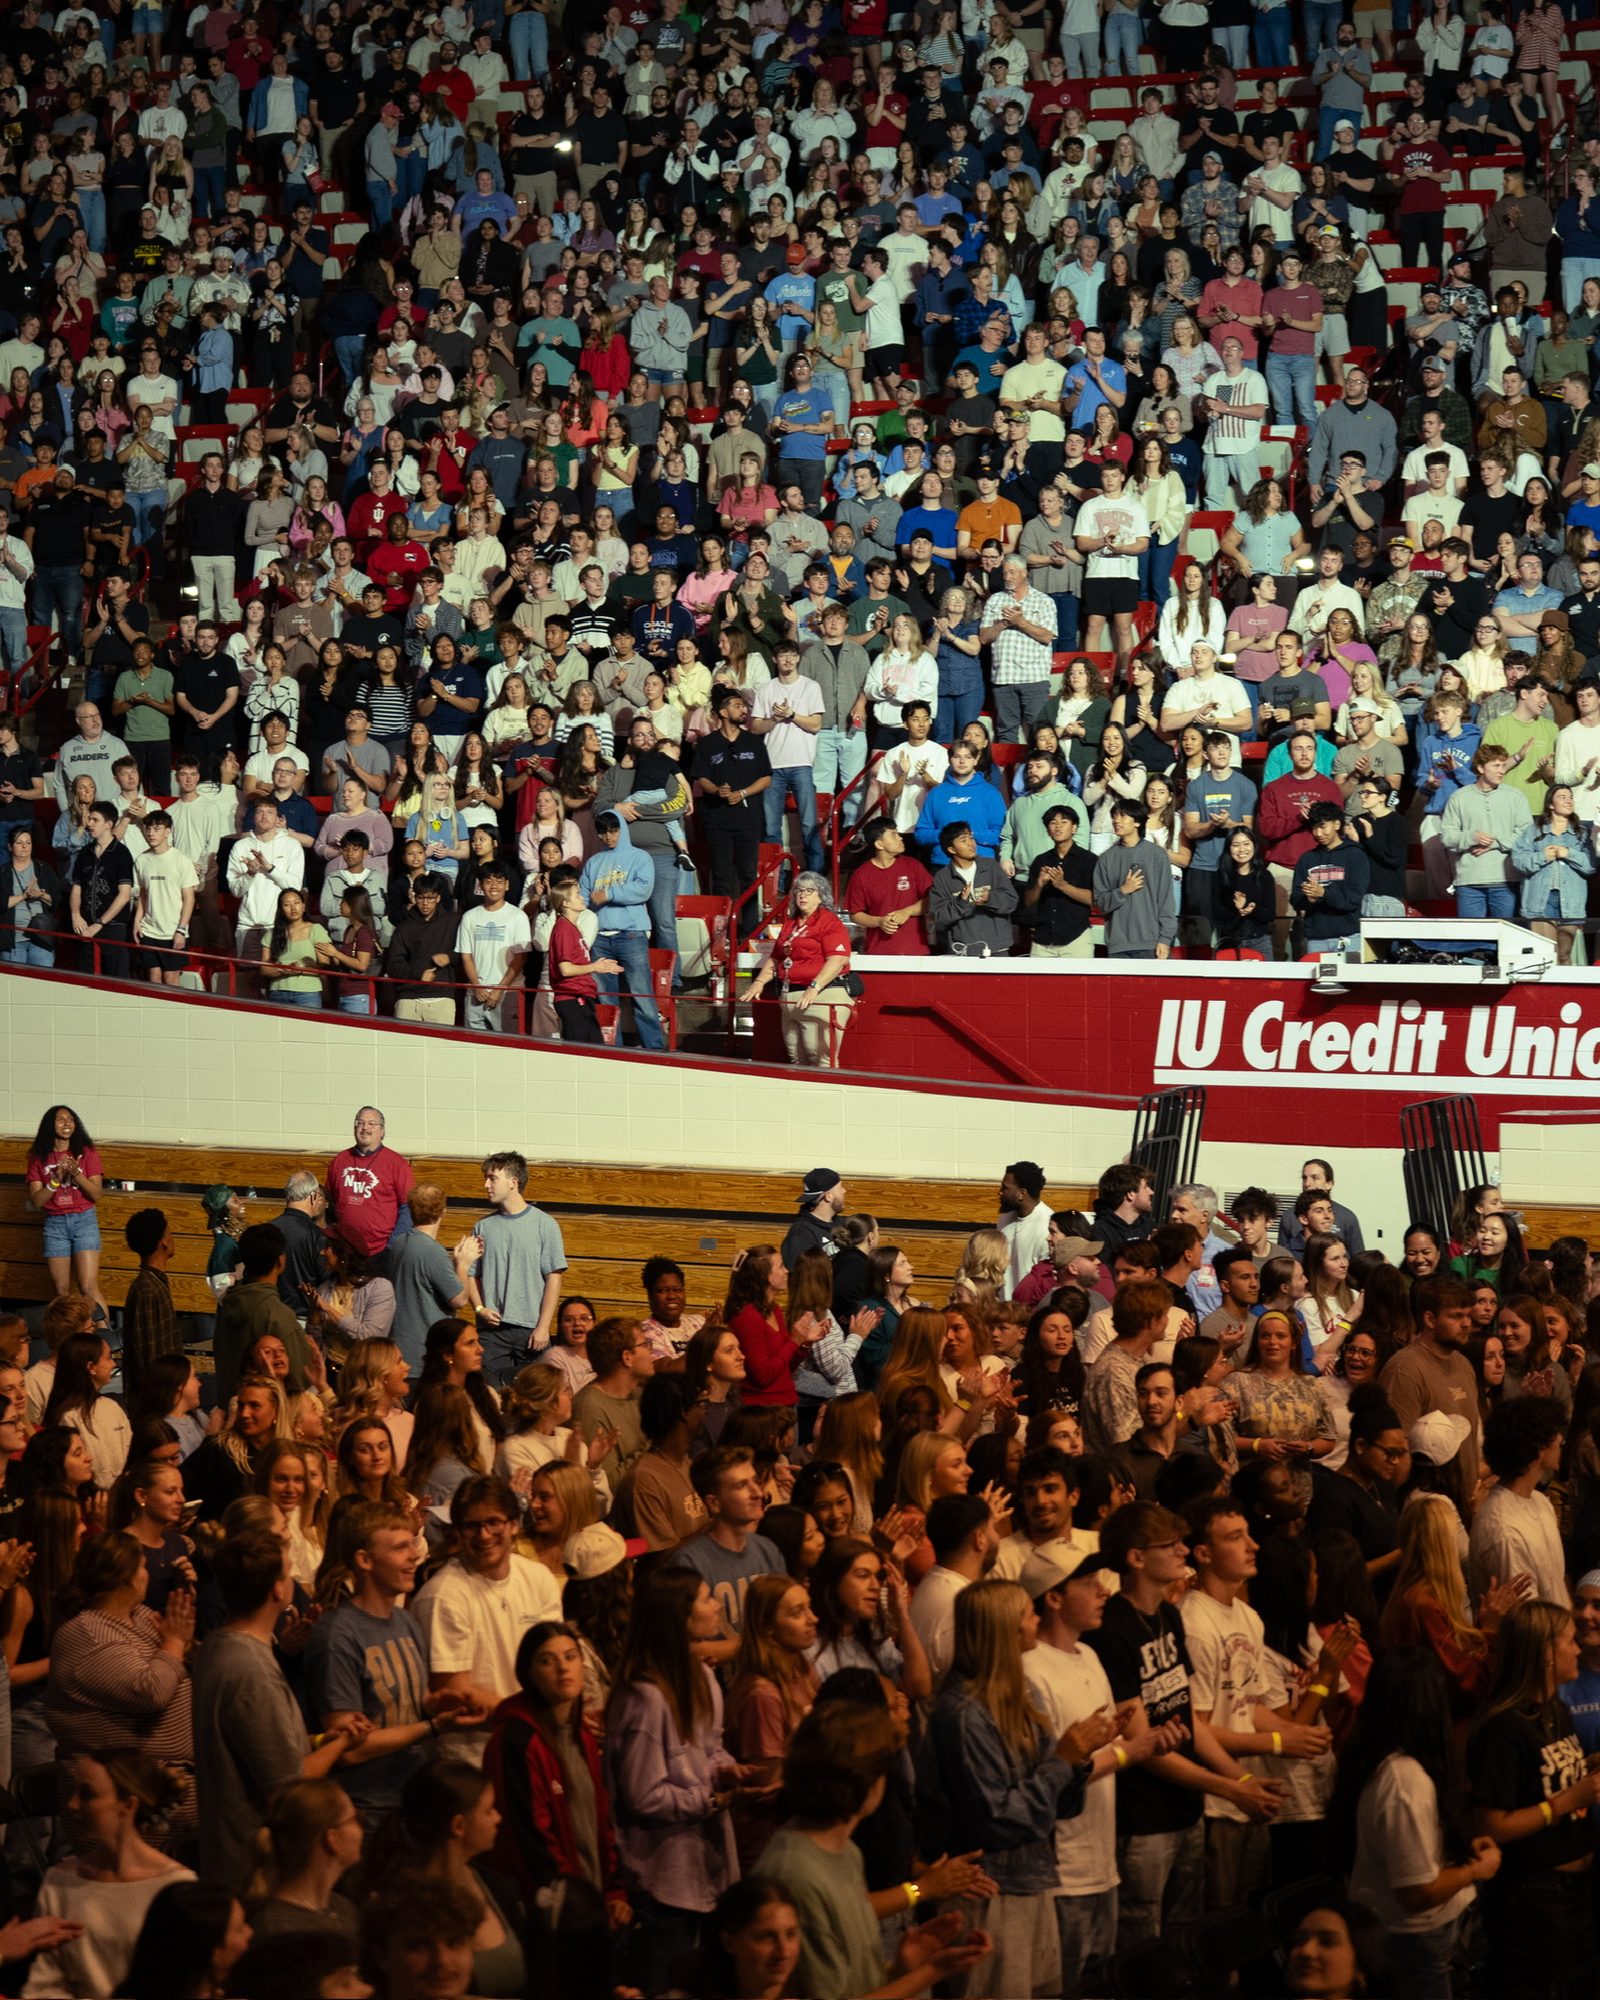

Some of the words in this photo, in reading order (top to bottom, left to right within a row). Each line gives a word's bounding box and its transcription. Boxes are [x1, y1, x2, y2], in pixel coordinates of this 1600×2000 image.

[70, 753, 109, 763] RAIDERS
[1154, 1000, 1226, 1069] IU
[1241, 1000, 1447, 1073] Credit
